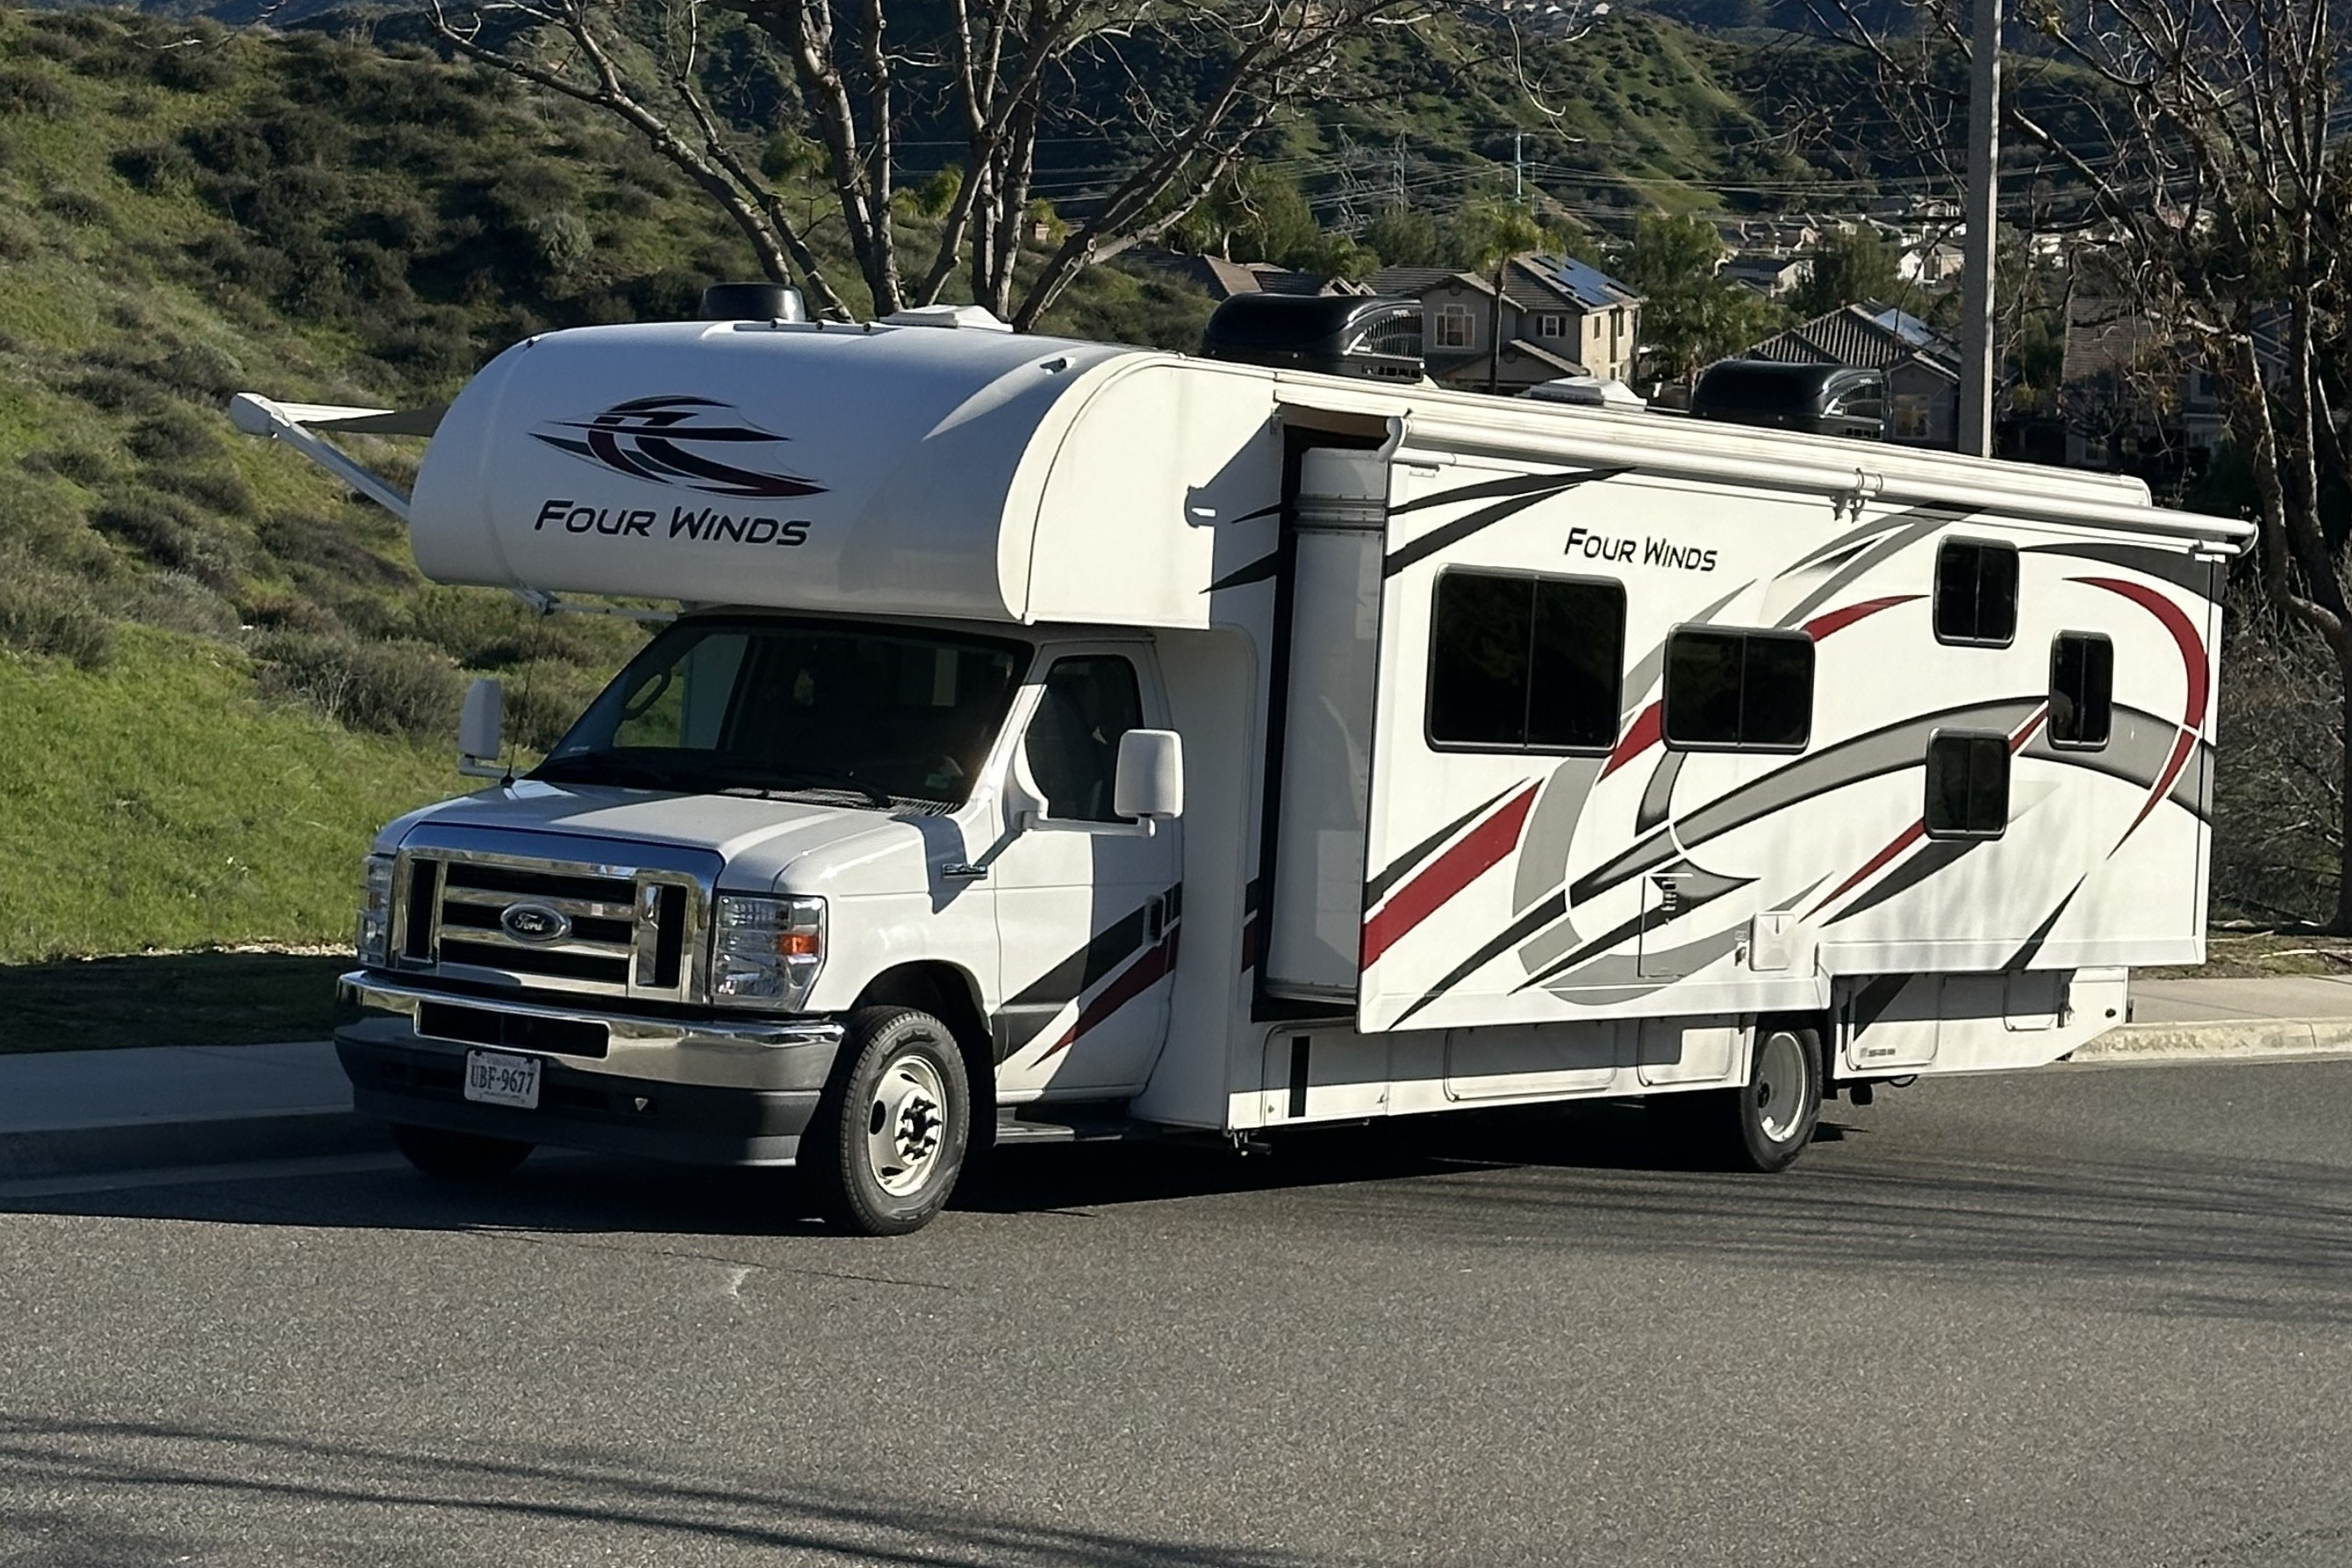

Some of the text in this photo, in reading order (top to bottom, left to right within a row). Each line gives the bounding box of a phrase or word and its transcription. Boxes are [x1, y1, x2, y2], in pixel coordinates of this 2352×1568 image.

[534, 499, 812, 547] FOUR WINDS
[1564, 526, 1718, 572] FOUR WINDS
[514, 912, 545, 931] Ford
